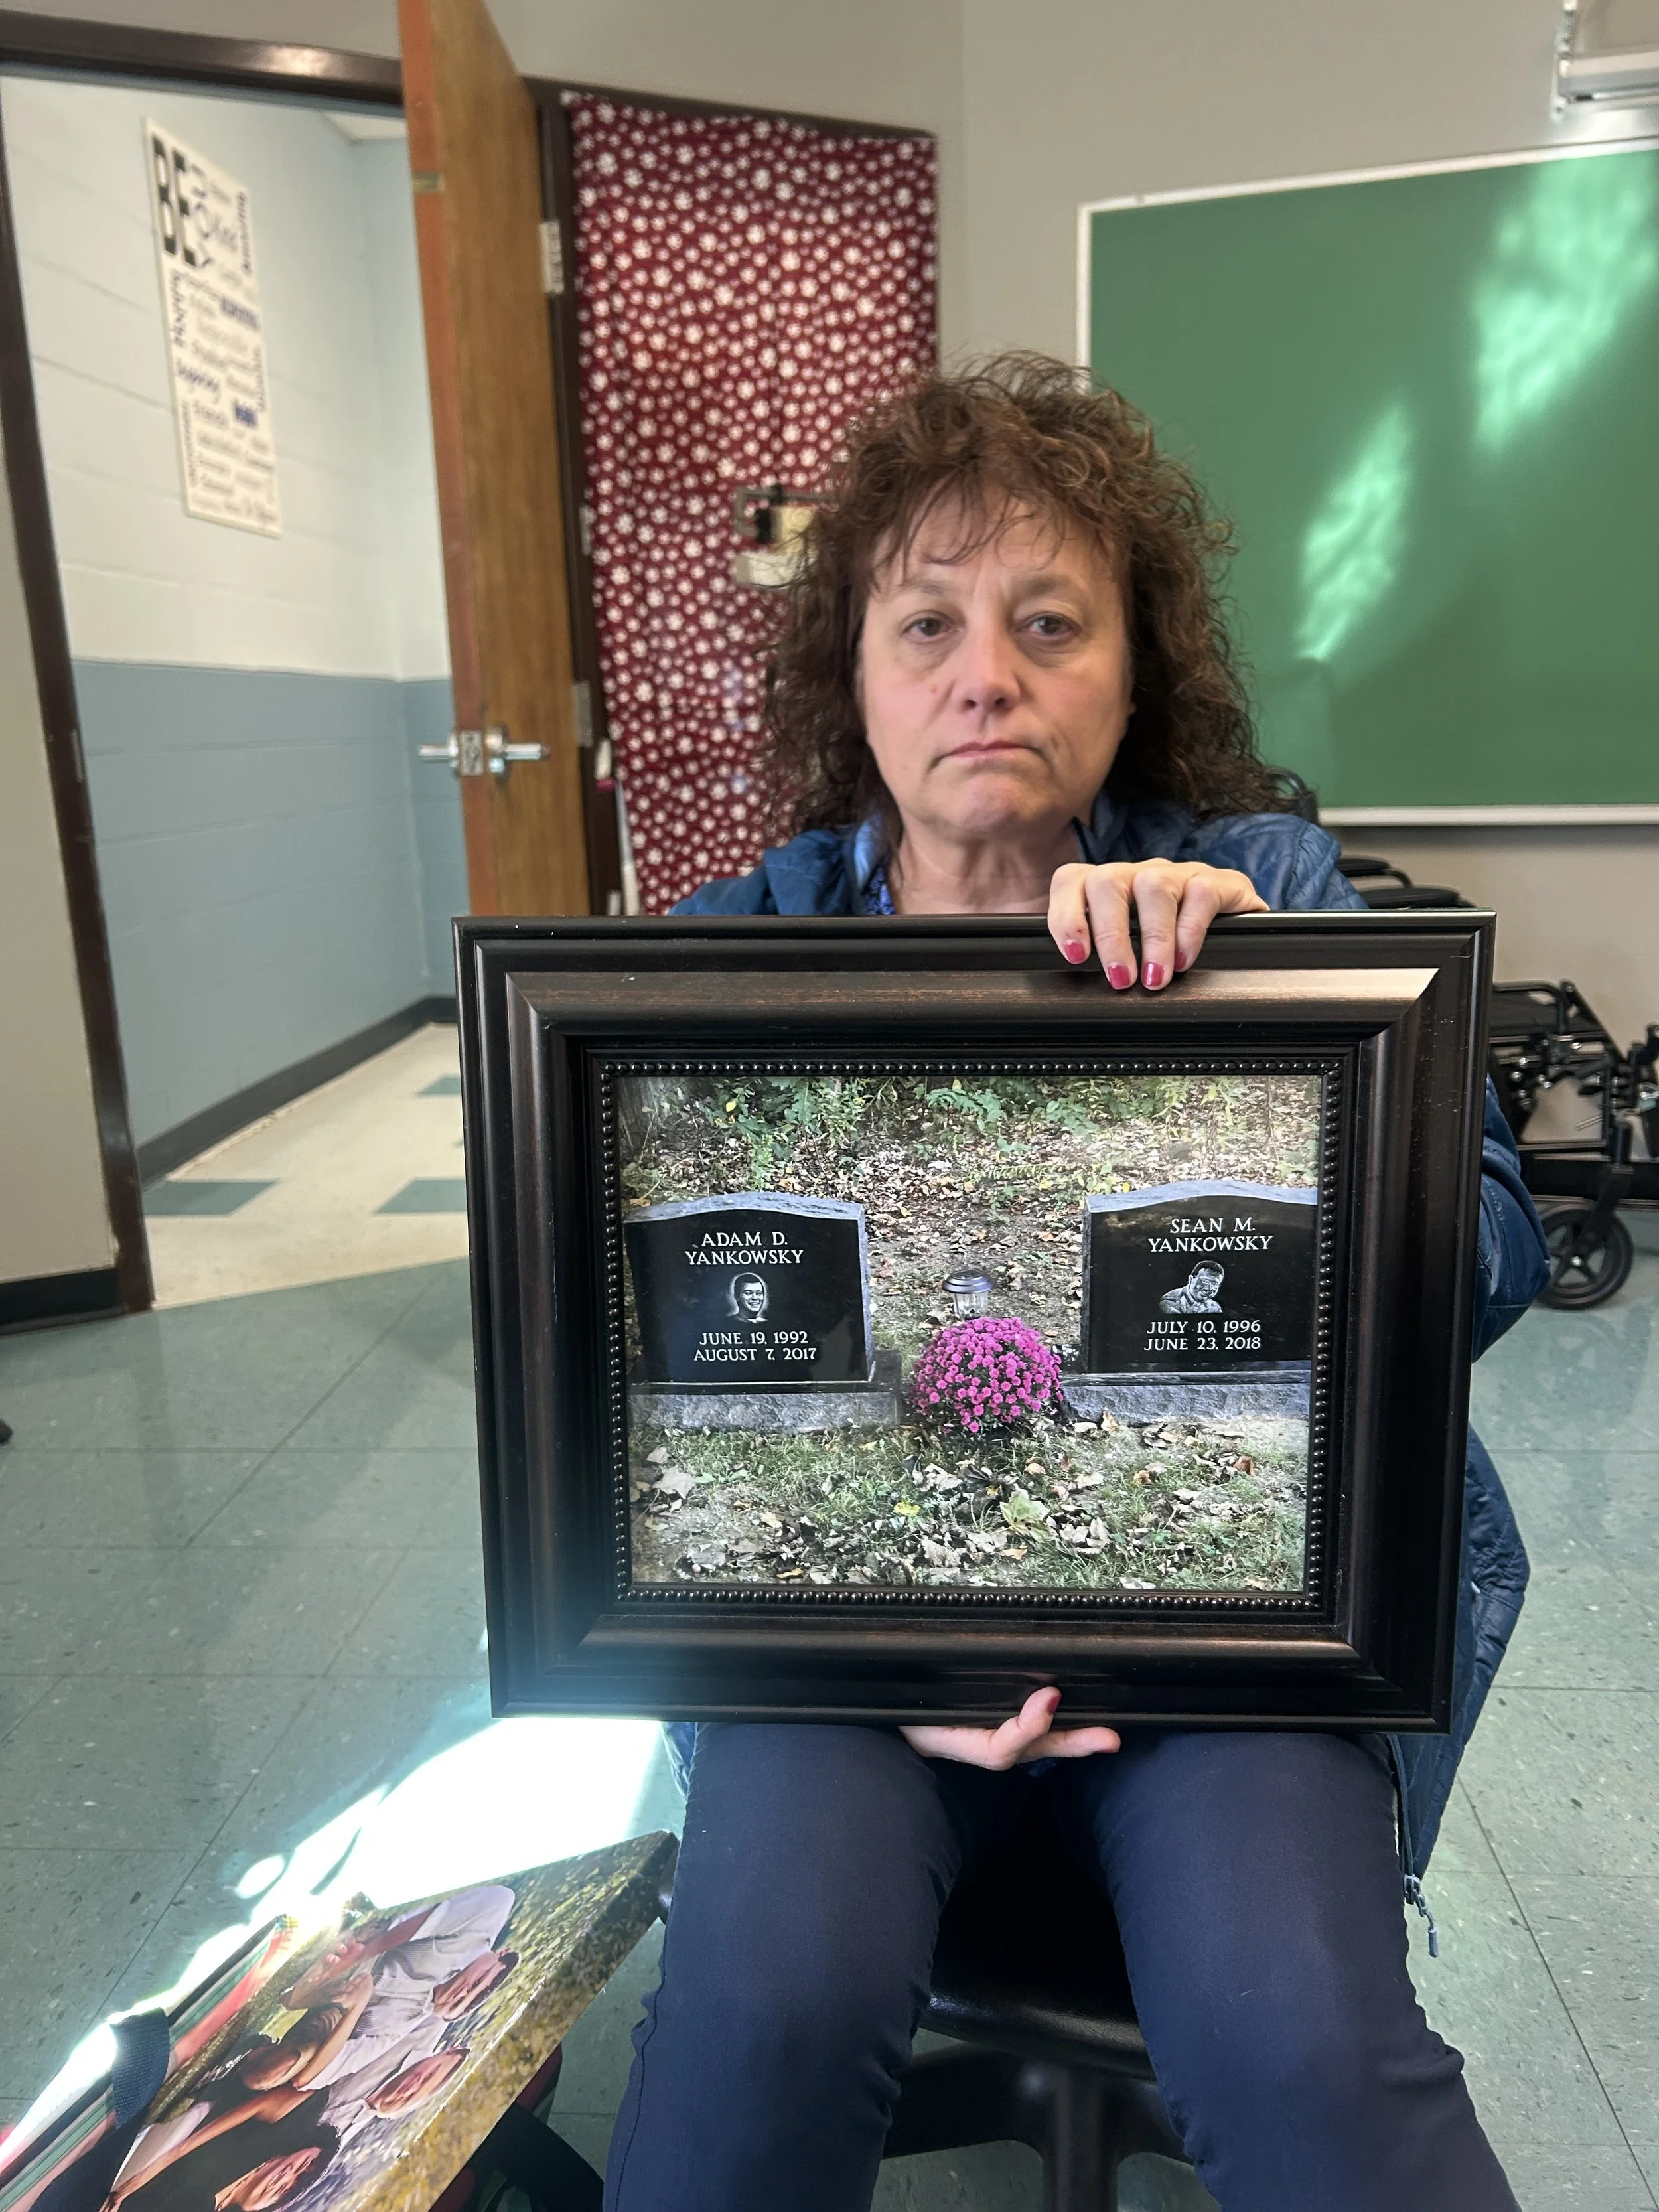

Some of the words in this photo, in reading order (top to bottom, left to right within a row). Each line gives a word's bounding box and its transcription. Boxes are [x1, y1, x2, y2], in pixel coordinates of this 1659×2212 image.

[1168, 1217, 1224, 1234] SEAN
[1233, 1217, 1256, 1232] M.
[701, 1232, 762, 1247] ADAM
[771, 1231, 788, 1246] D.
[1147, 1235, 1273, 1252] YANKOWSKY
[685, 1249, 804, 1265] YANKOWSKY
[1146, 1321, 1189, 1334] JULY
[1223, 1319, 1261, 1333] 1996
[699, 1332, 743, 1345] JUNE
[773, 1331, 808, 1344] 1992
[1143, 1338, 1189, 1351] JUNE
[1224, 1336, 1261, 1350] 2018
[693, 1348, 757, 1361] AUGUST
[782, 1347, 817, 1360] 2017
